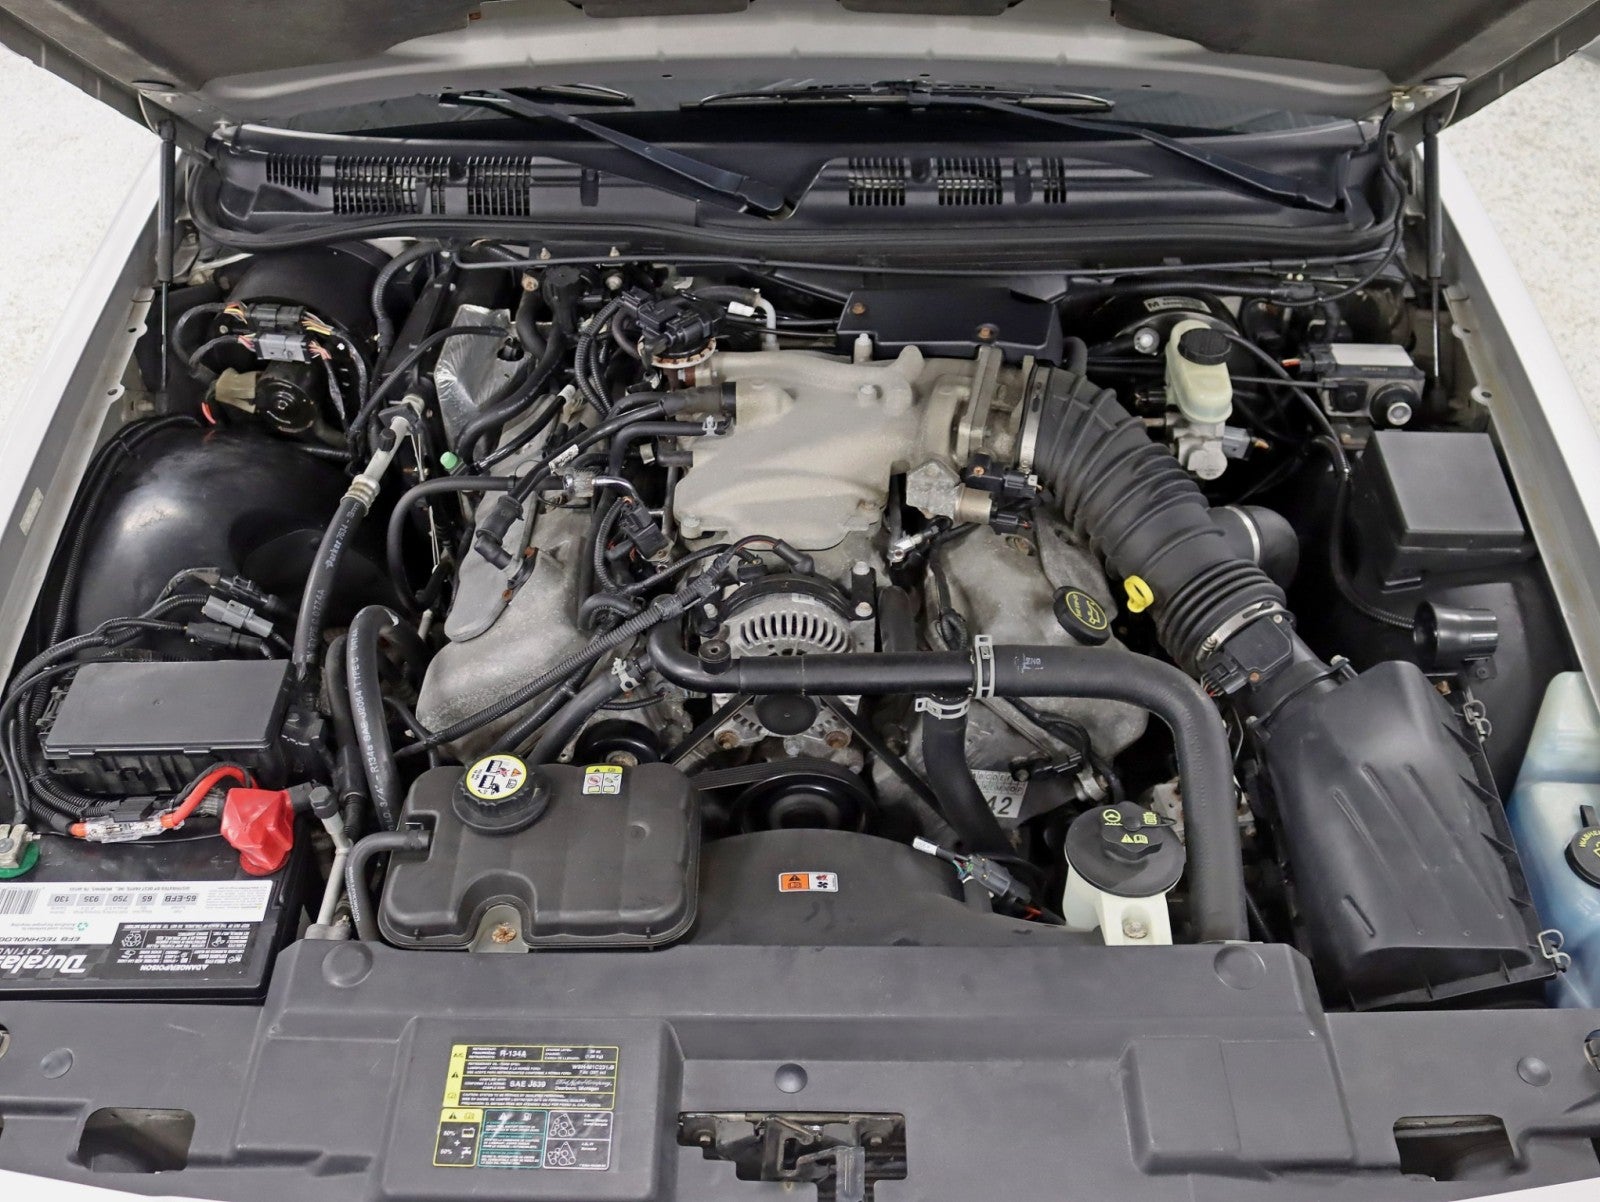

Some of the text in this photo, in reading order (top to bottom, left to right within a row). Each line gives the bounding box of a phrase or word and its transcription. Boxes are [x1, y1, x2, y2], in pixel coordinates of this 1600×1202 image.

[54, 895, 70, 903] 130
[83, 895, 100, 903] 935
[112, 895, 128, 903] 750
[142, 895, 153, 903] 65
[164, 895, 197, 903] 65-EFB
[499, 1049, 527, 1058] R-134A
[509, 1080, 526, 1088] SAE
